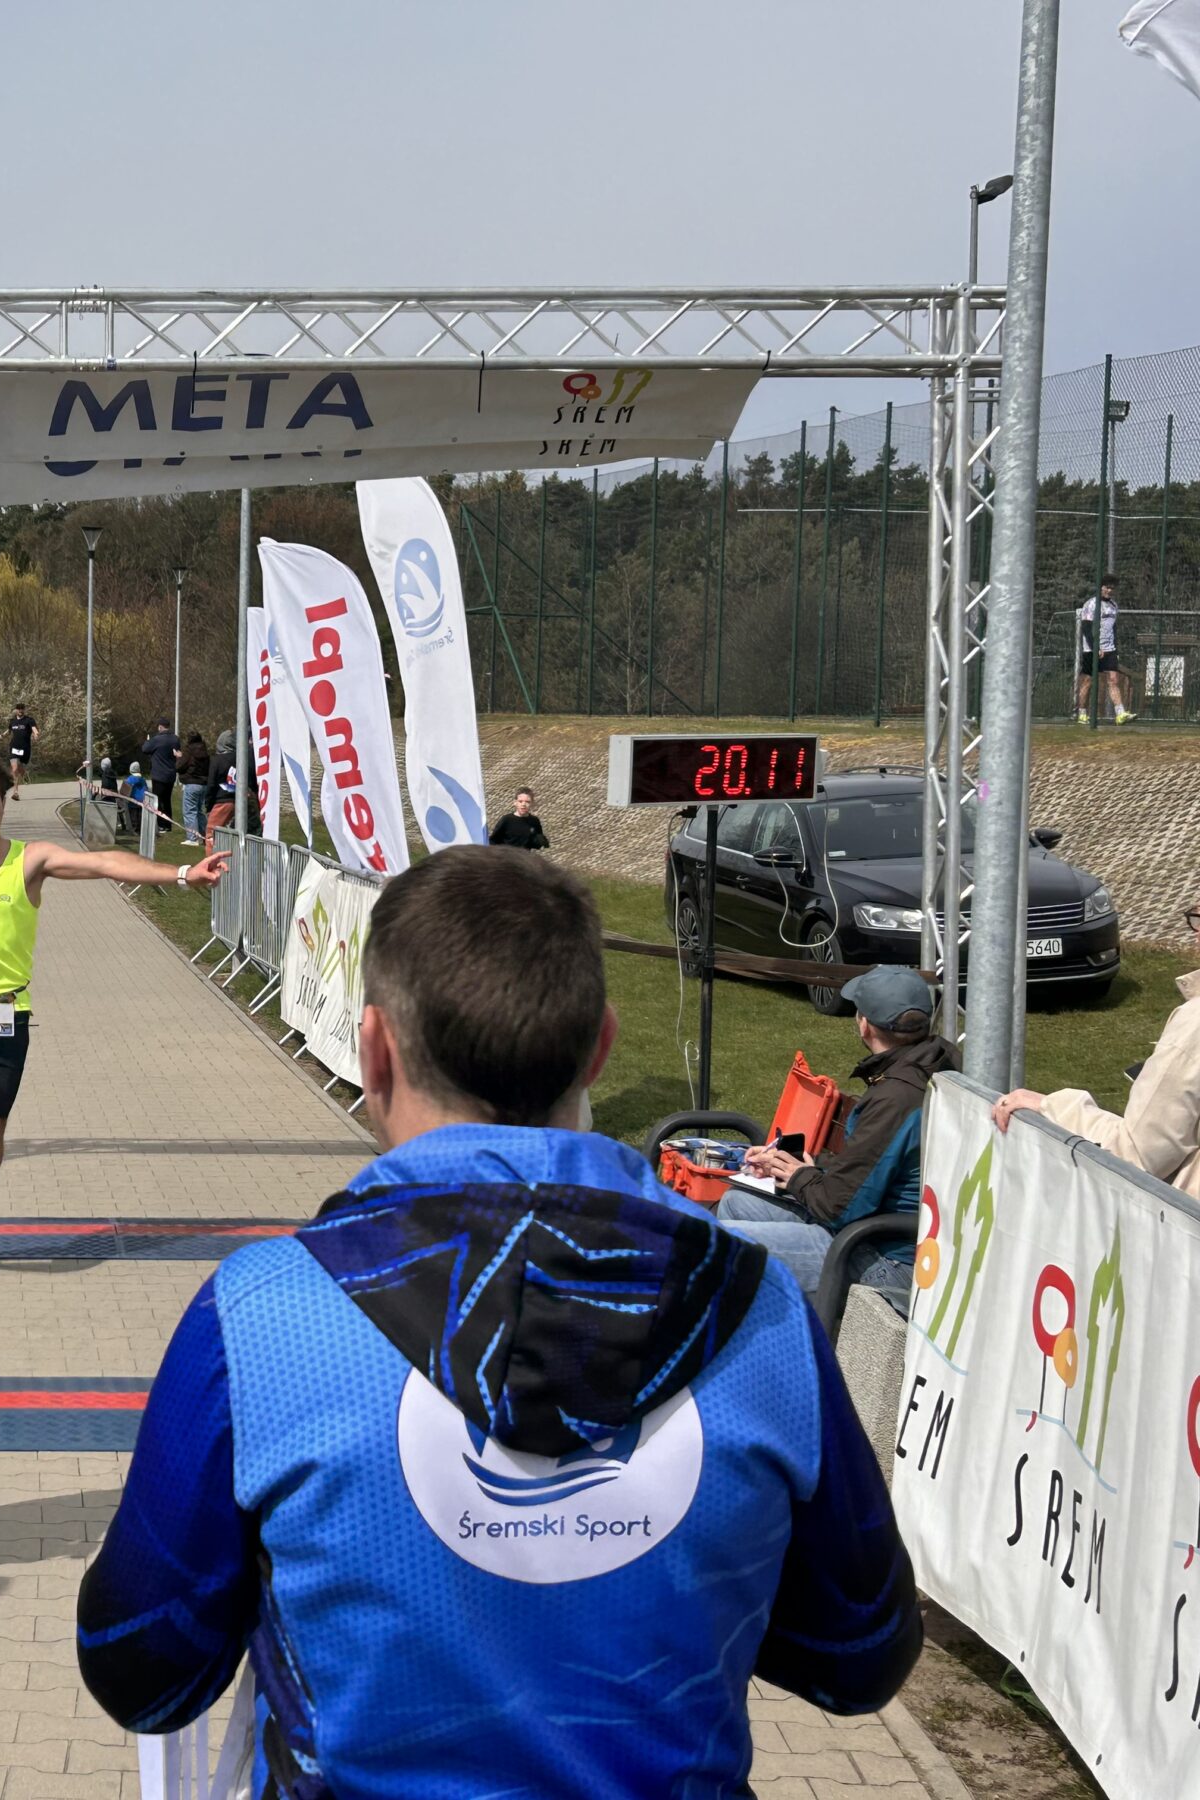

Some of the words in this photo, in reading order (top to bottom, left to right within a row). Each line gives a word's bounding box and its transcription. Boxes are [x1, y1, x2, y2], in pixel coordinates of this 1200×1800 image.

[48, 372, 374, 437] META
[694, 745, 805, 796] 20.11
[1026, 939, 1061, 956] 5640
[458, 1510, 565, 1540] Śremski
[574, 1514, 653, 1542] Sport
